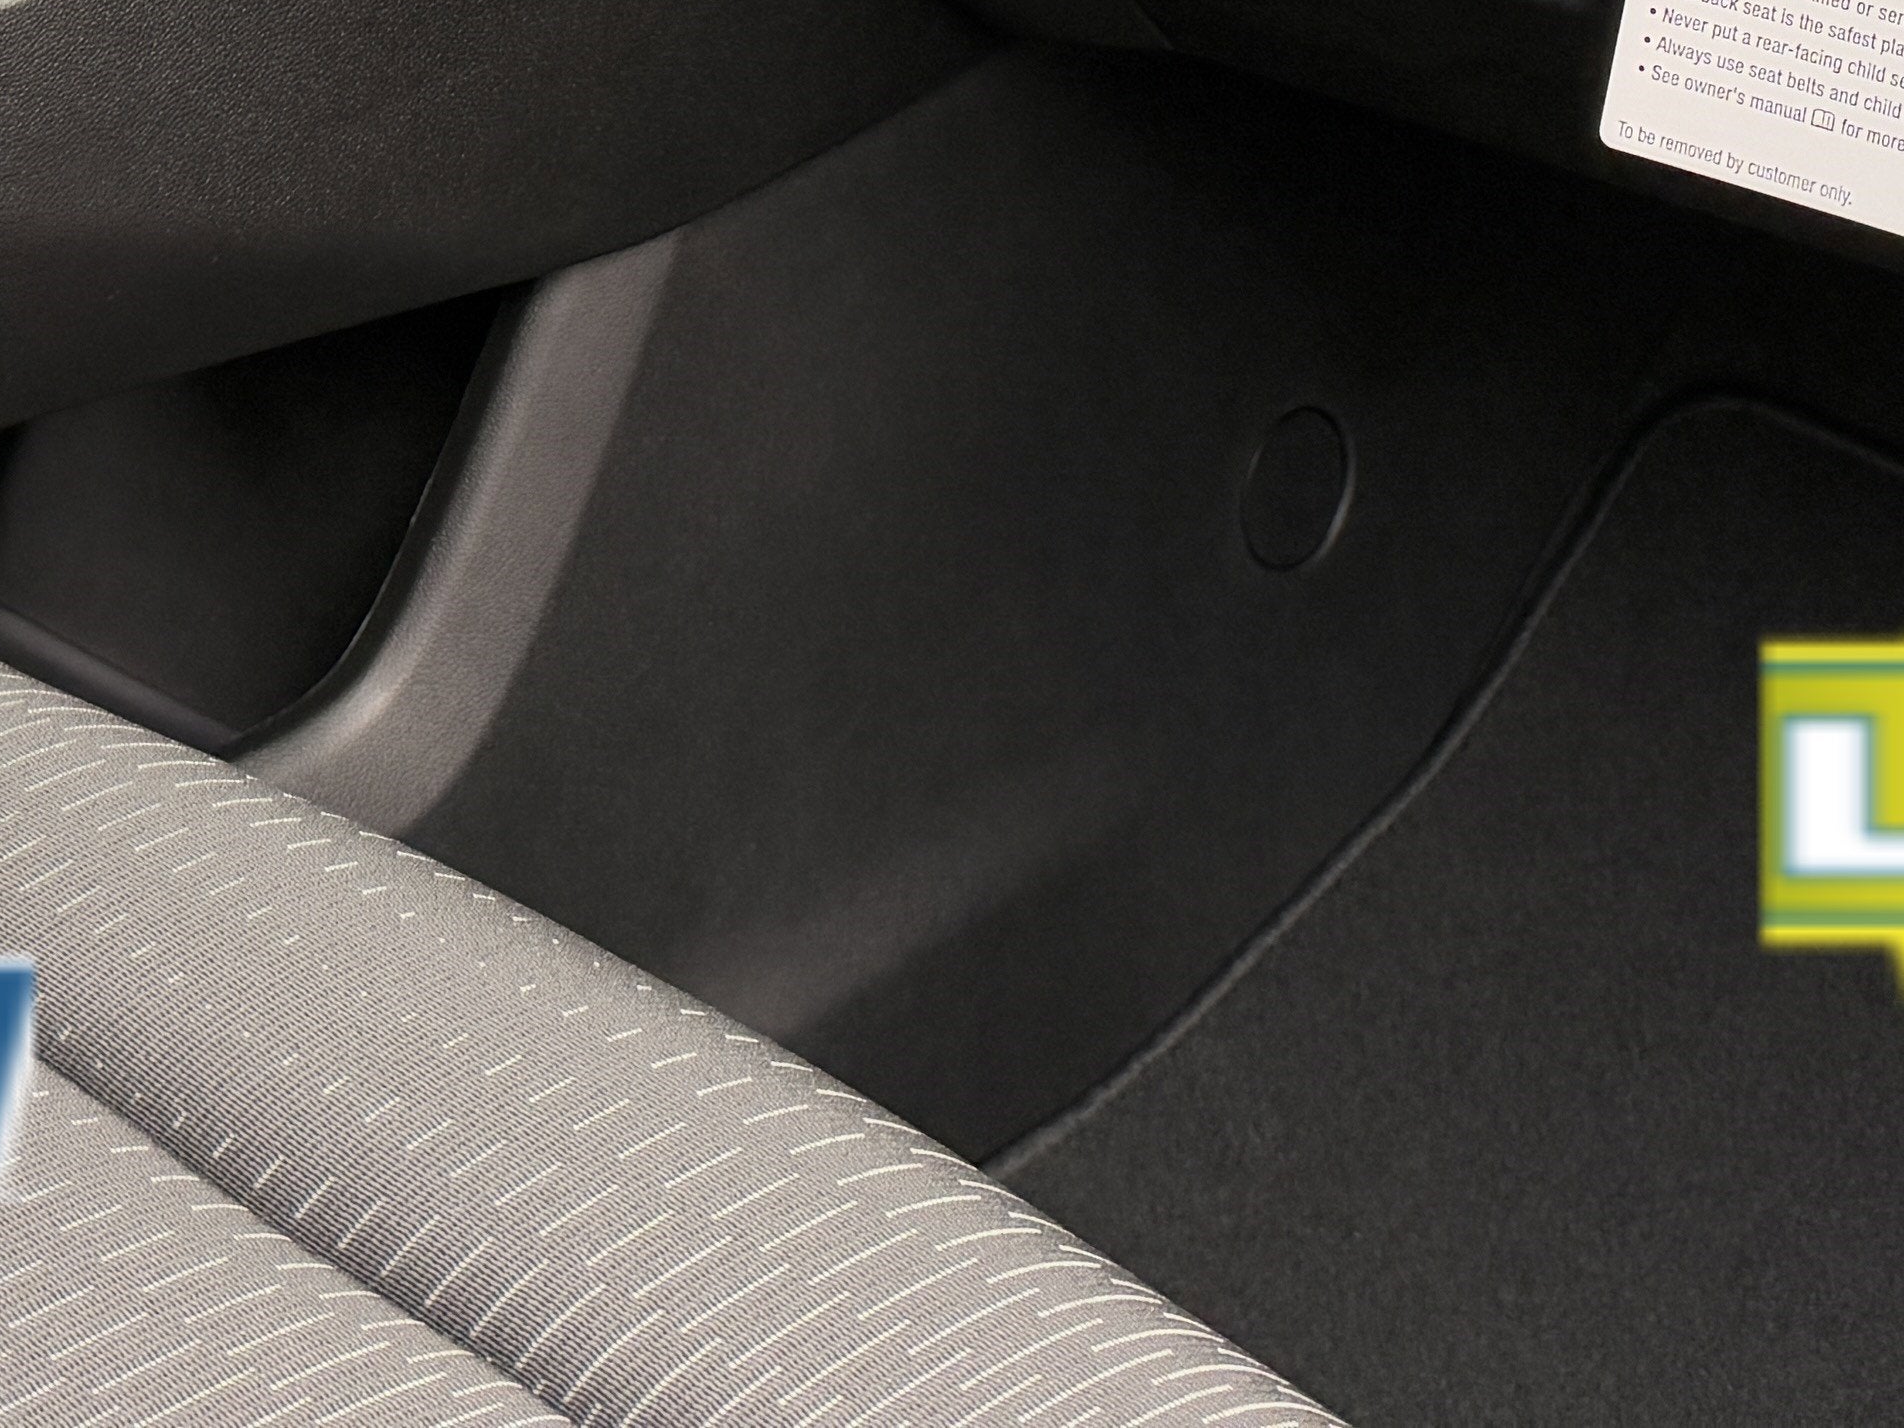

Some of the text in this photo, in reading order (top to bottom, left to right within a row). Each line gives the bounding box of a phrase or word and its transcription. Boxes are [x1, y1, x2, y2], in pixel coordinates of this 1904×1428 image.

[1661, 6, 1709, 33] Never
[1710, 22, 1738, 42] put
[1740, 31, 1752, 46] a
[1754, 34, 1843, 75] rear-facing
[1846, 59, 1887, 83] child
[1741, 0, 1778, 22] seat
[1779, 6, 1795, 27] is
[1798, 12, 1824, 35] the
[1826, 23, 1877, 50] safest
[1855, 0, 1875, 17] or
[1650, 63, 1680, 87] See
[1683, 76, 1746, 106] owner's
[1748, 94, 1808, 123] manual
[1839, 117, 1864, 139] for
[1654, 35, 1713, 66] Always
[1715, 54, 1745, 74] use
[1747, 63, 1783, 86] seat
[1785, 70, 1826, 97] belts
[1827, 86, 1860, 107] and
[1862, 94, 1903, 120] child
[1617, 118, 1852, 207] To be removed by customer only.
